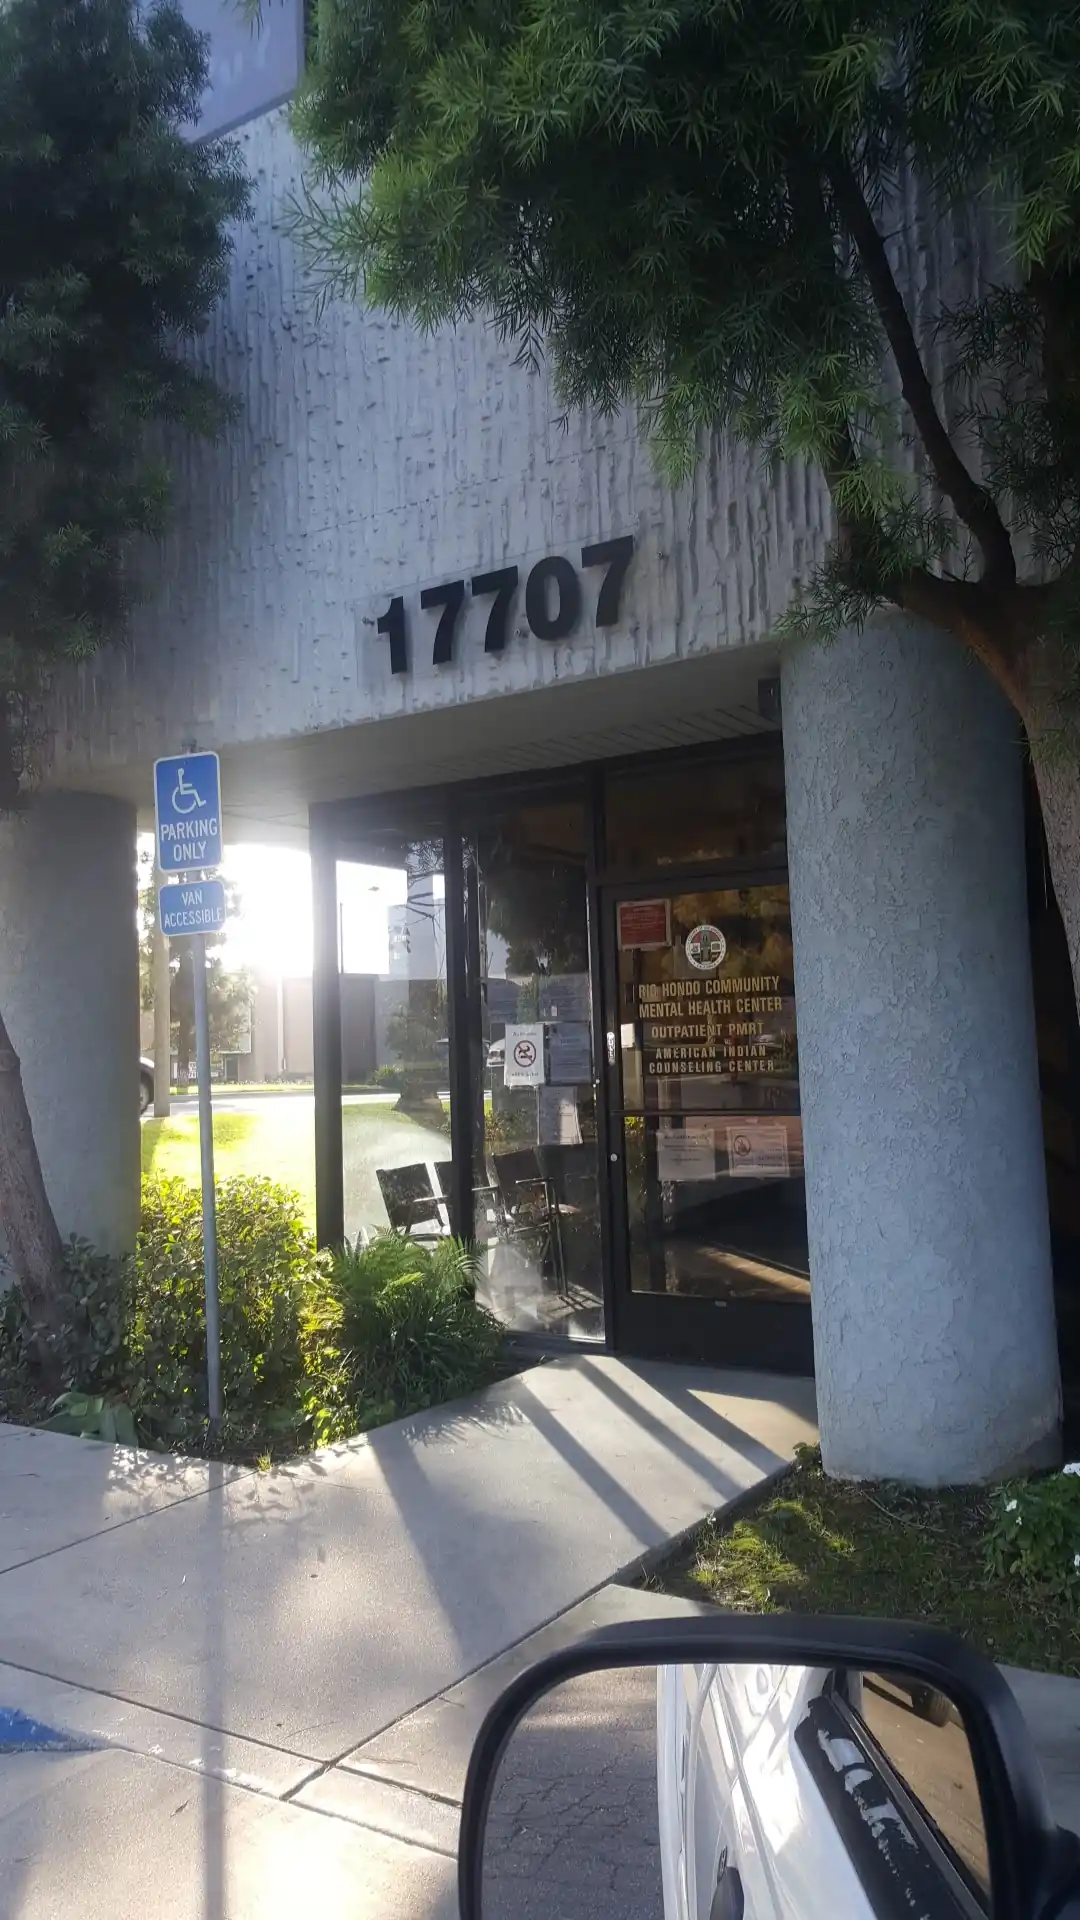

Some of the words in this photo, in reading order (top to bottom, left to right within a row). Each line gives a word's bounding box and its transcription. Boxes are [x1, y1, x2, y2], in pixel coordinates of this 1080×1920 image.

[377, 534, 634, 675] 17707
[160, 818, 218, 841] PARKING
[173, 841, 207, 862] ONLY
[182, 888, 203, 906] VAN
[164, 907, 223, 928] ACCESSIBLE
[639, 983, 657, 998] RIO
[662, 980, 701, 997] HONDO
[705, 975, 780, 994] COMMUNITY
[639, 1002, 684, 1018] MENTAL
[688, 999, 731, 1015] HEALTH
[736, 996, 783, 1013] CENTER
[651, 1023, 723, 1038] OUTPATIENT
[728, 1022, 765, 1036] PMRT
[655, 1046, 716, 1060] AMERICAN
[723, 1045, 766, 1057] INDIAN
[649, 1060, 722, 1074] COUNSELING
[729, 1059, 775, 1072] CENTER
